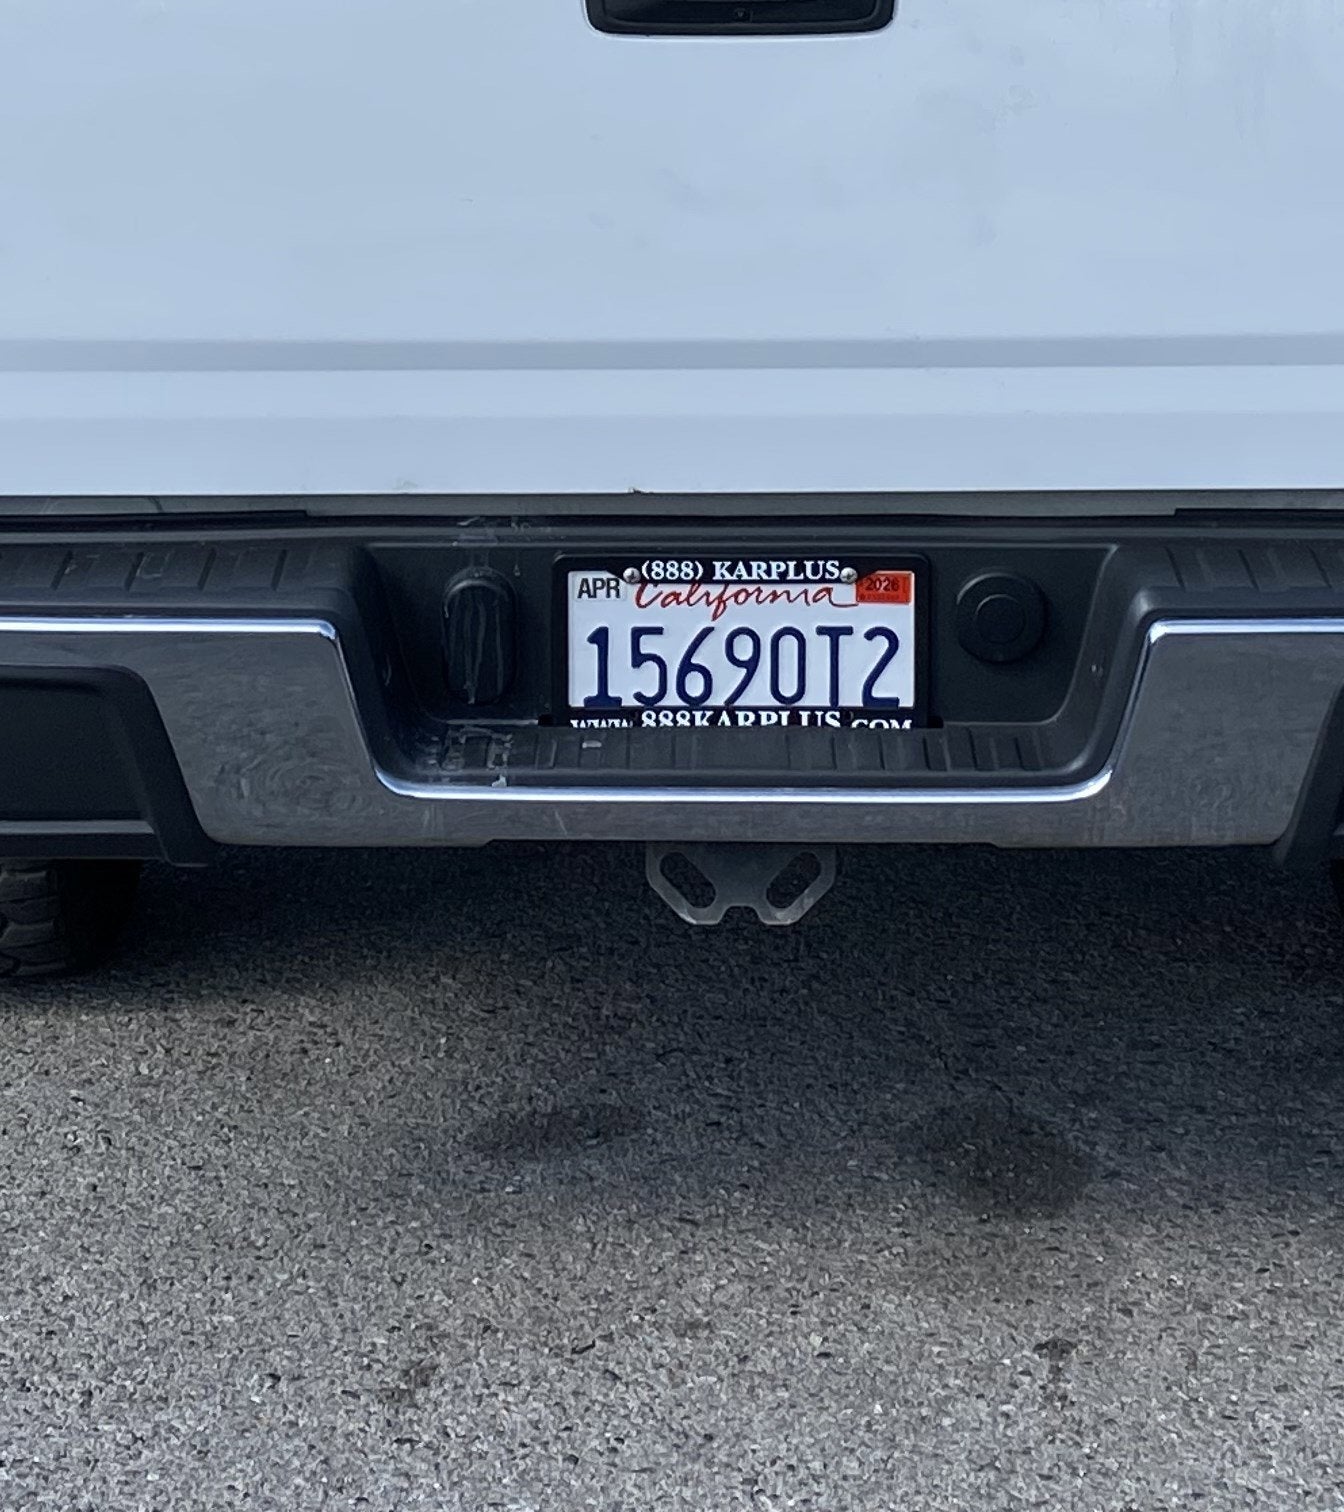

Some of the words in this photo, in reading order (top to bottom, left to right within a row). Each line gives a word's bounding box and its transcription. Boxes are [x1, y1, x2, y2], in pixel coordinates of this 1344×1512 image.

[640, 560, 705, 581] (888)
[712, 560, 841, 581] KARPLUS
[577, 577, 621, 600] APR
[633, 580, 860, 621] California
[583, 625, 901, 709] 15690T2
